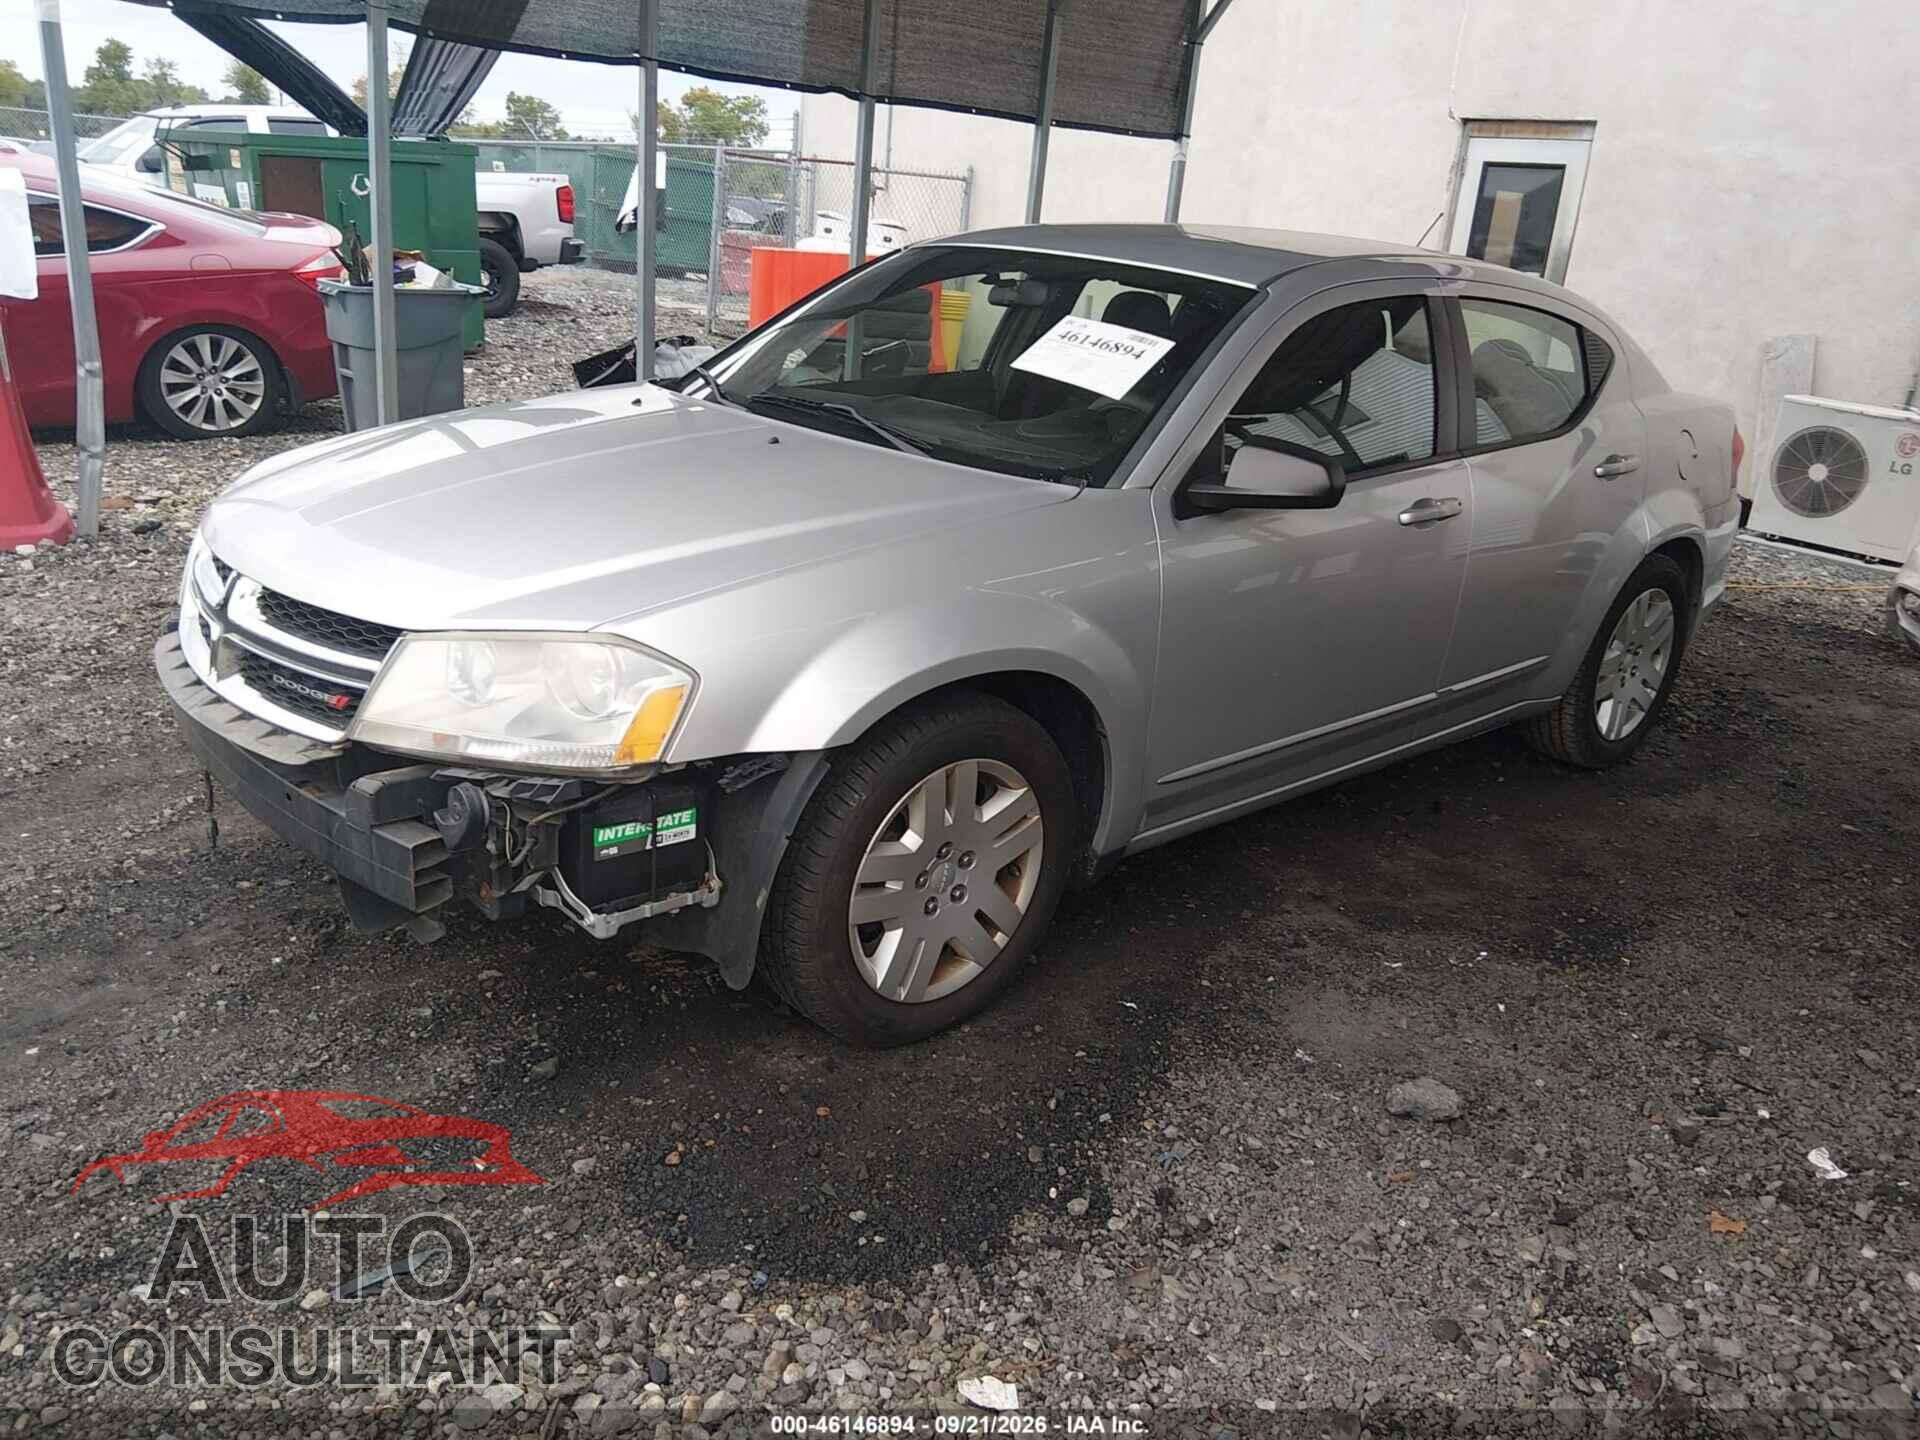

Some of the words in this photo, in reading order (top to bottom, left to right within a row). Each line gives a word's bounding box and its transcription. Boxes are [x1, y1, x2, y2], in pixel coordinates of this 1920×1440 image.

[1058, 330, 1146, 360] 46146894
[1889, 460, 1913, 476] LG
[272, 674, 336, 704] DODGE
